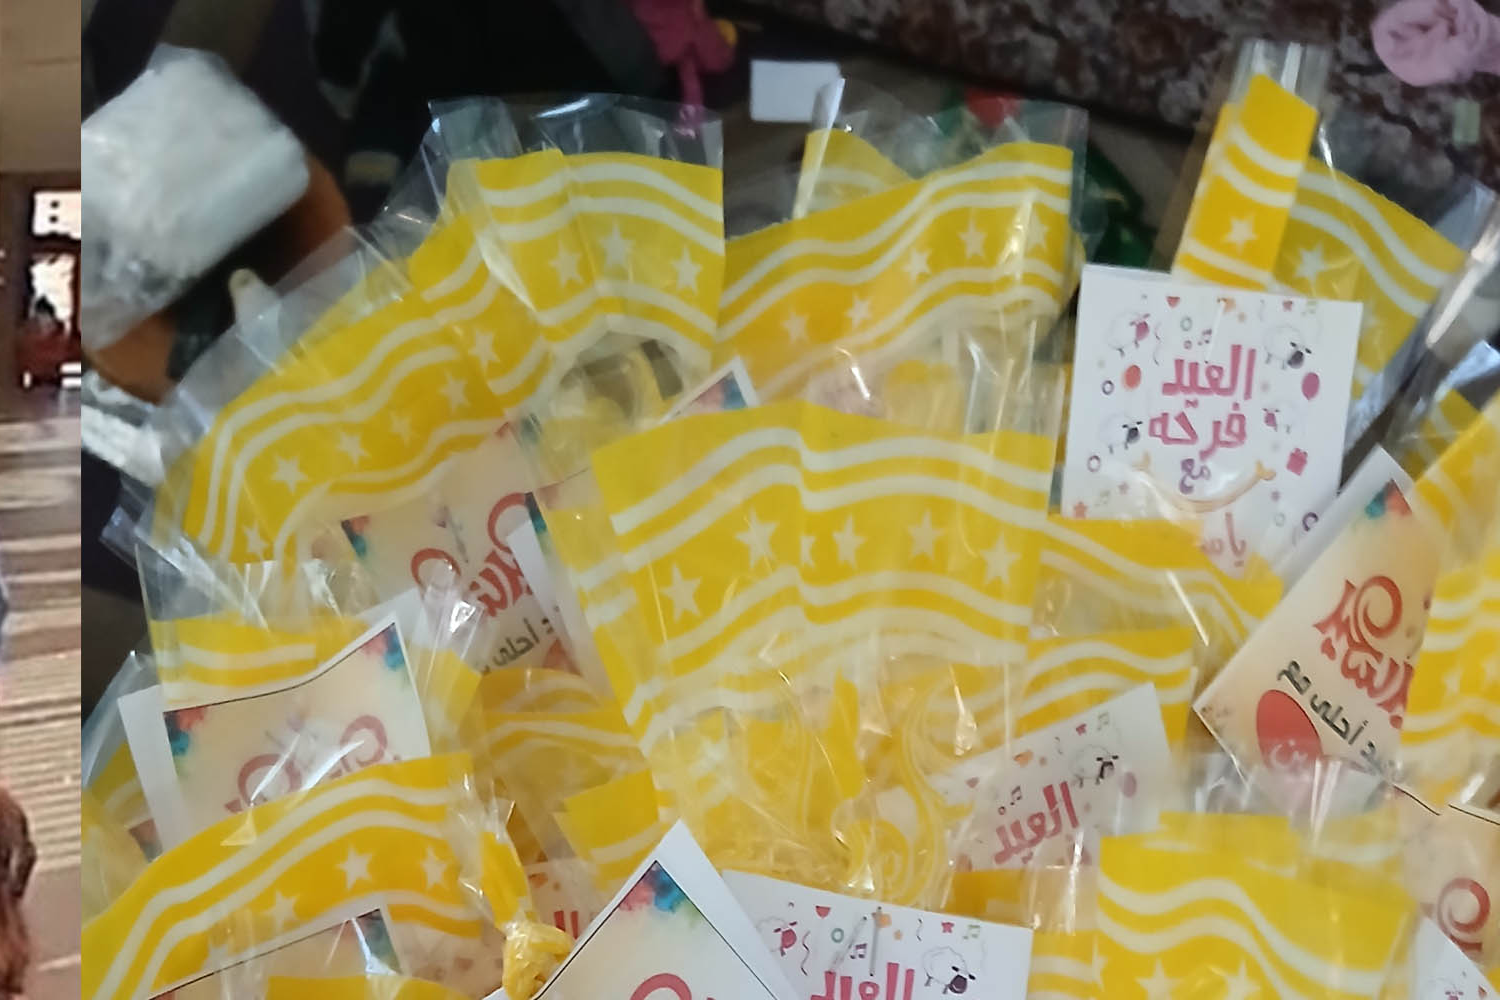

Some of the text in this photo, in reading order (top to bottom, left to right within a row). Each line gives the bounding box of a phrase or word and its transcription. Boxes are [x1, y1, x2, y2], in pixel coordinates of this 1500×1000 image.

[1161, 344, 1257, 408] العيد
[1179, 458, 1211, 494] مع
[1277, 660, 1311, 695] مع
[993, 781, 1079, 865] العيد
